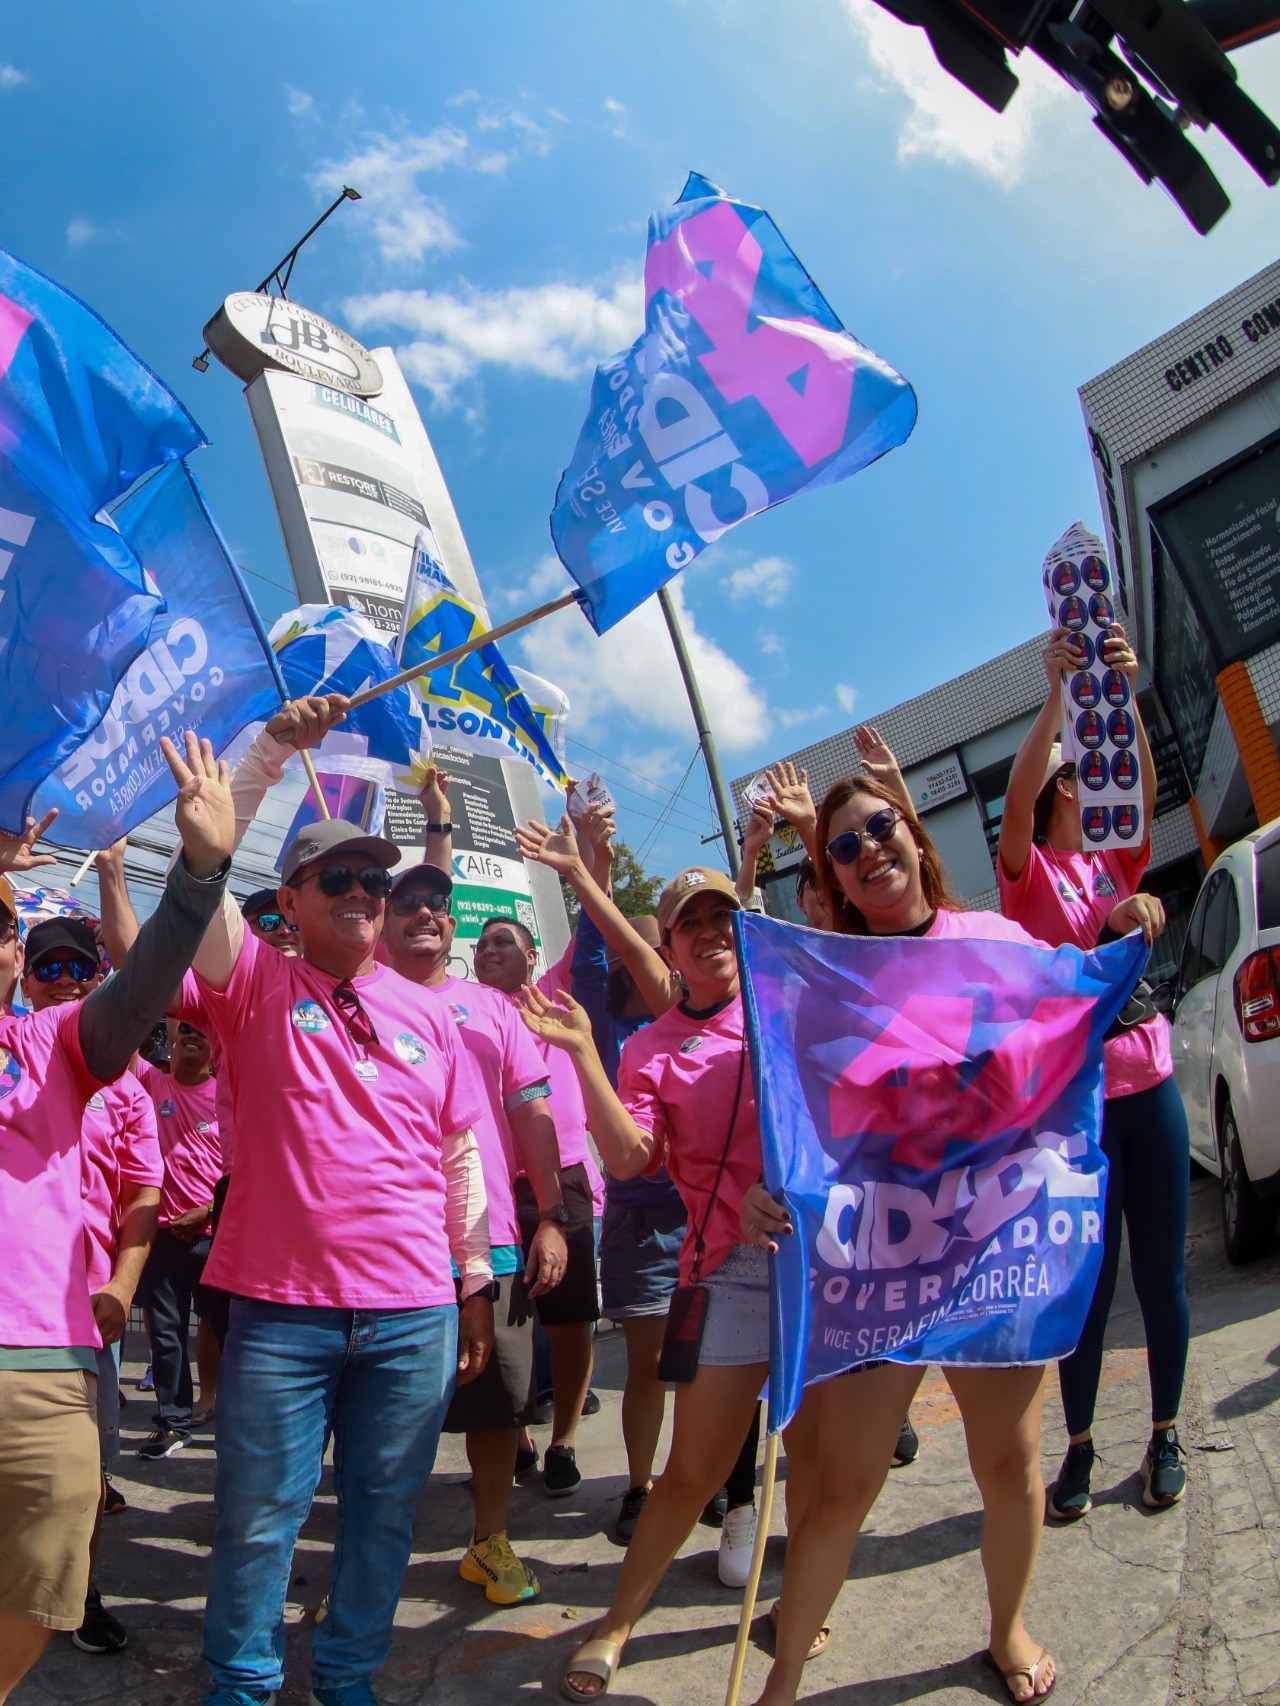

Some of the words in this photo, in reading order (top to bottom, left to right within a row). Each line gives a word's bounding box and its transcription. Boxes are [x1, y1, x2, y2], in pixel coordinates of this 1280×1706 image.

[286, 306, 375, 364] COMERCIAL
[1164, 334, 1234, 391] CENTRO
[1241, 298, 1280, 342] COM
[275, 349, 362, 391] BOULEVARD
[322, 387, 393, 434] CELULARES
[328, 471, 377, 493] RESTORE
[1205, 513, 1256, 548] Harmonização
[1210, 523, 1262, 558] Preenchimento
[340, 573, 357, 583] (92)
[1214, 552, 1236, 569] Botox
[1220, 544, 1271, 579] Bioestimulador
[1224, 579, 1237, 590] Fio
[1237, 572, 1247, 582] de
[1247, 550, 1280, 577] Sustentaç
[1229, 565, 1280, 600] Micropigmenta
[1233, 584, 1272, 611] Hidragloss
[1237, 595, 1276, 623] Pálpebras
[1242, 604, 1280, 634] Rinomodel
[425, 703, 503, 738] LSON
[467, 855, 504, 879] Alfa
[684, 871, 706, 887] LA
[457, 900, 471, 911] (92)
[829, 996, 1098, 1170] 44
[816, 1131, 1101, 1271] CIDADE
[805, 1211, 1101, 1312] GOVERNADOR
[823, 1327, 851, 1350] VICE
[855, 1298, 955, 1357] SERAFIM
[958, 1254, 1050, 1306] CORRÊA
